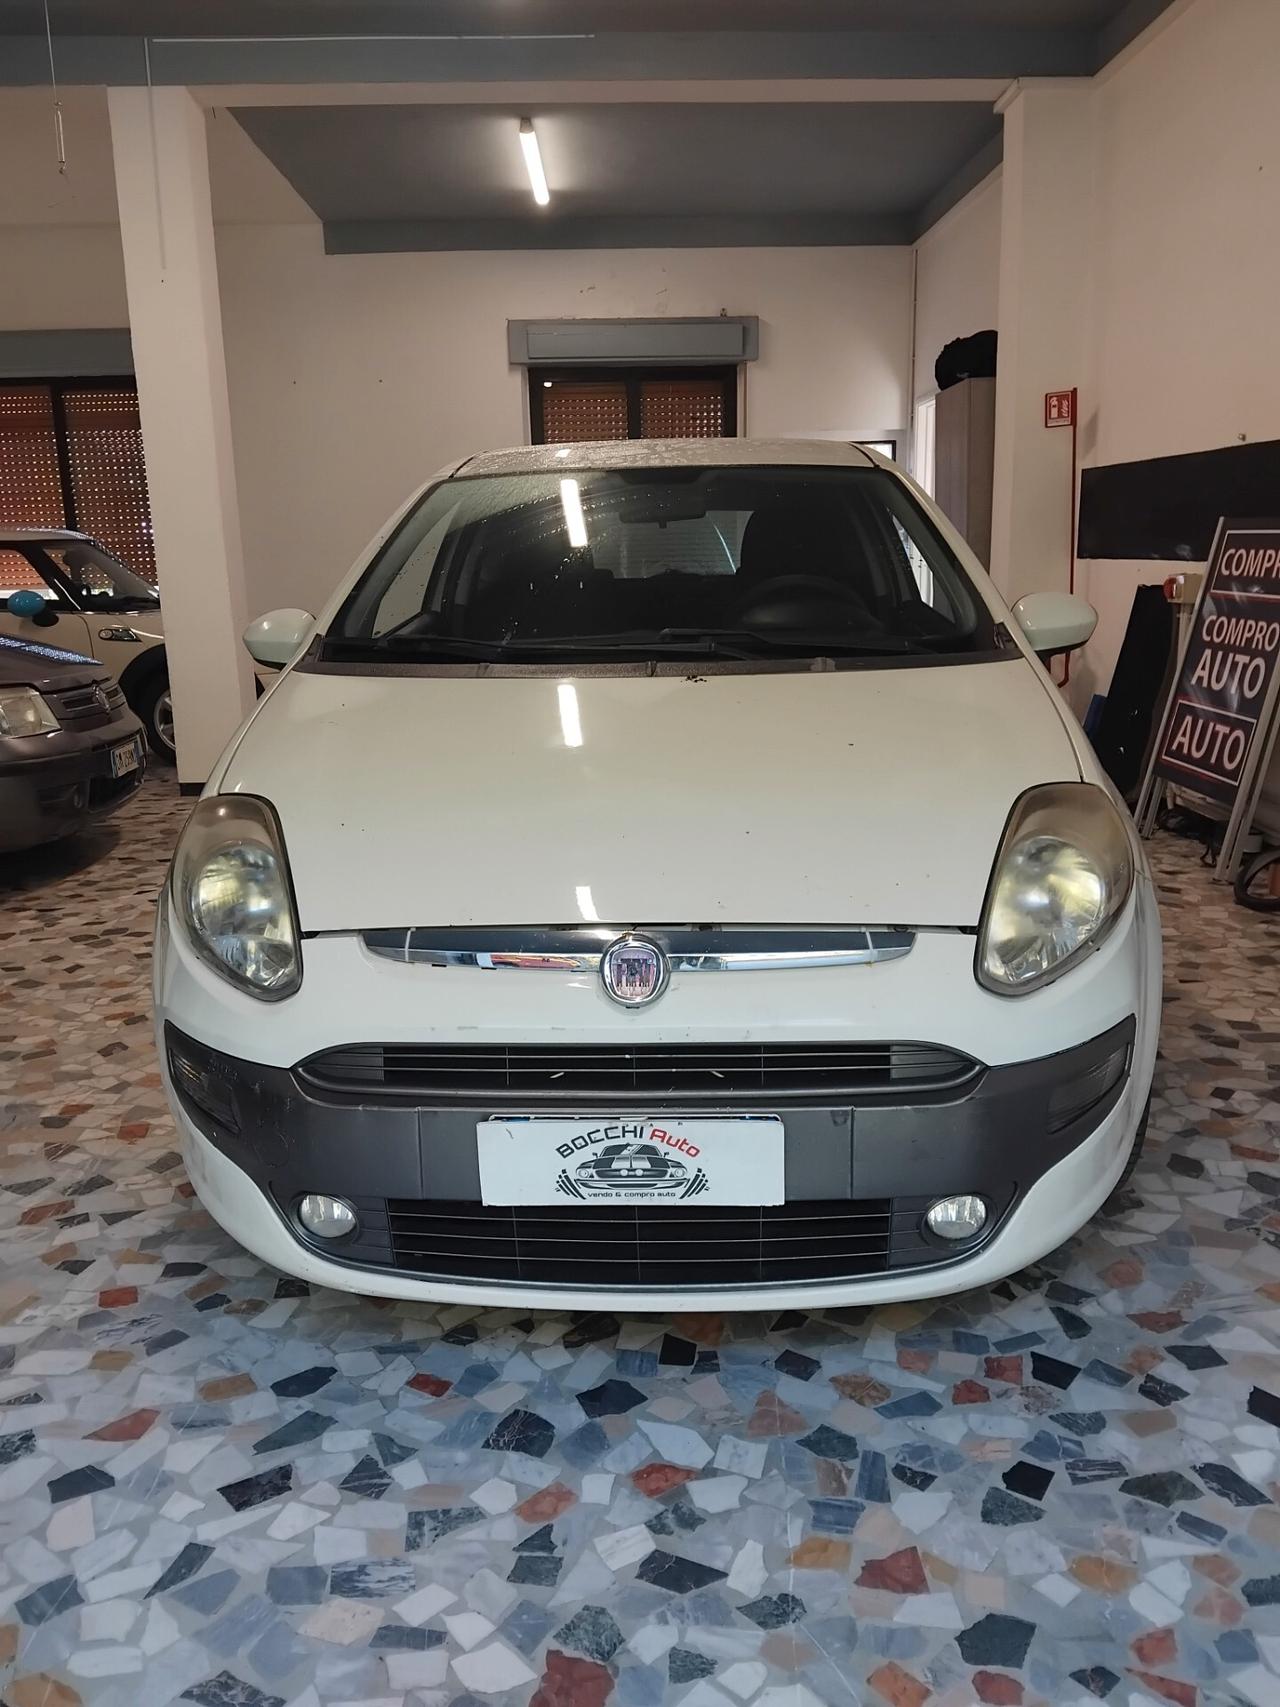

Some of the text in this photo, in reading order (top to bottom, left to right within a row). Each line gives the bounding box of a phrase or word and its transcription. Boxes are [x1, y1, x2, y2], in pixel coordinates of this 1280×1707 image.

[1202, 615, 1280, 652] COMPRO
[1190, 648, 1266, 699] AUTO
[1171, 715, 1246, 771] AUTO
[555, 1125, 701, 1159] BOCCHI Auto
[624, 1191, 656, 1199] compro
